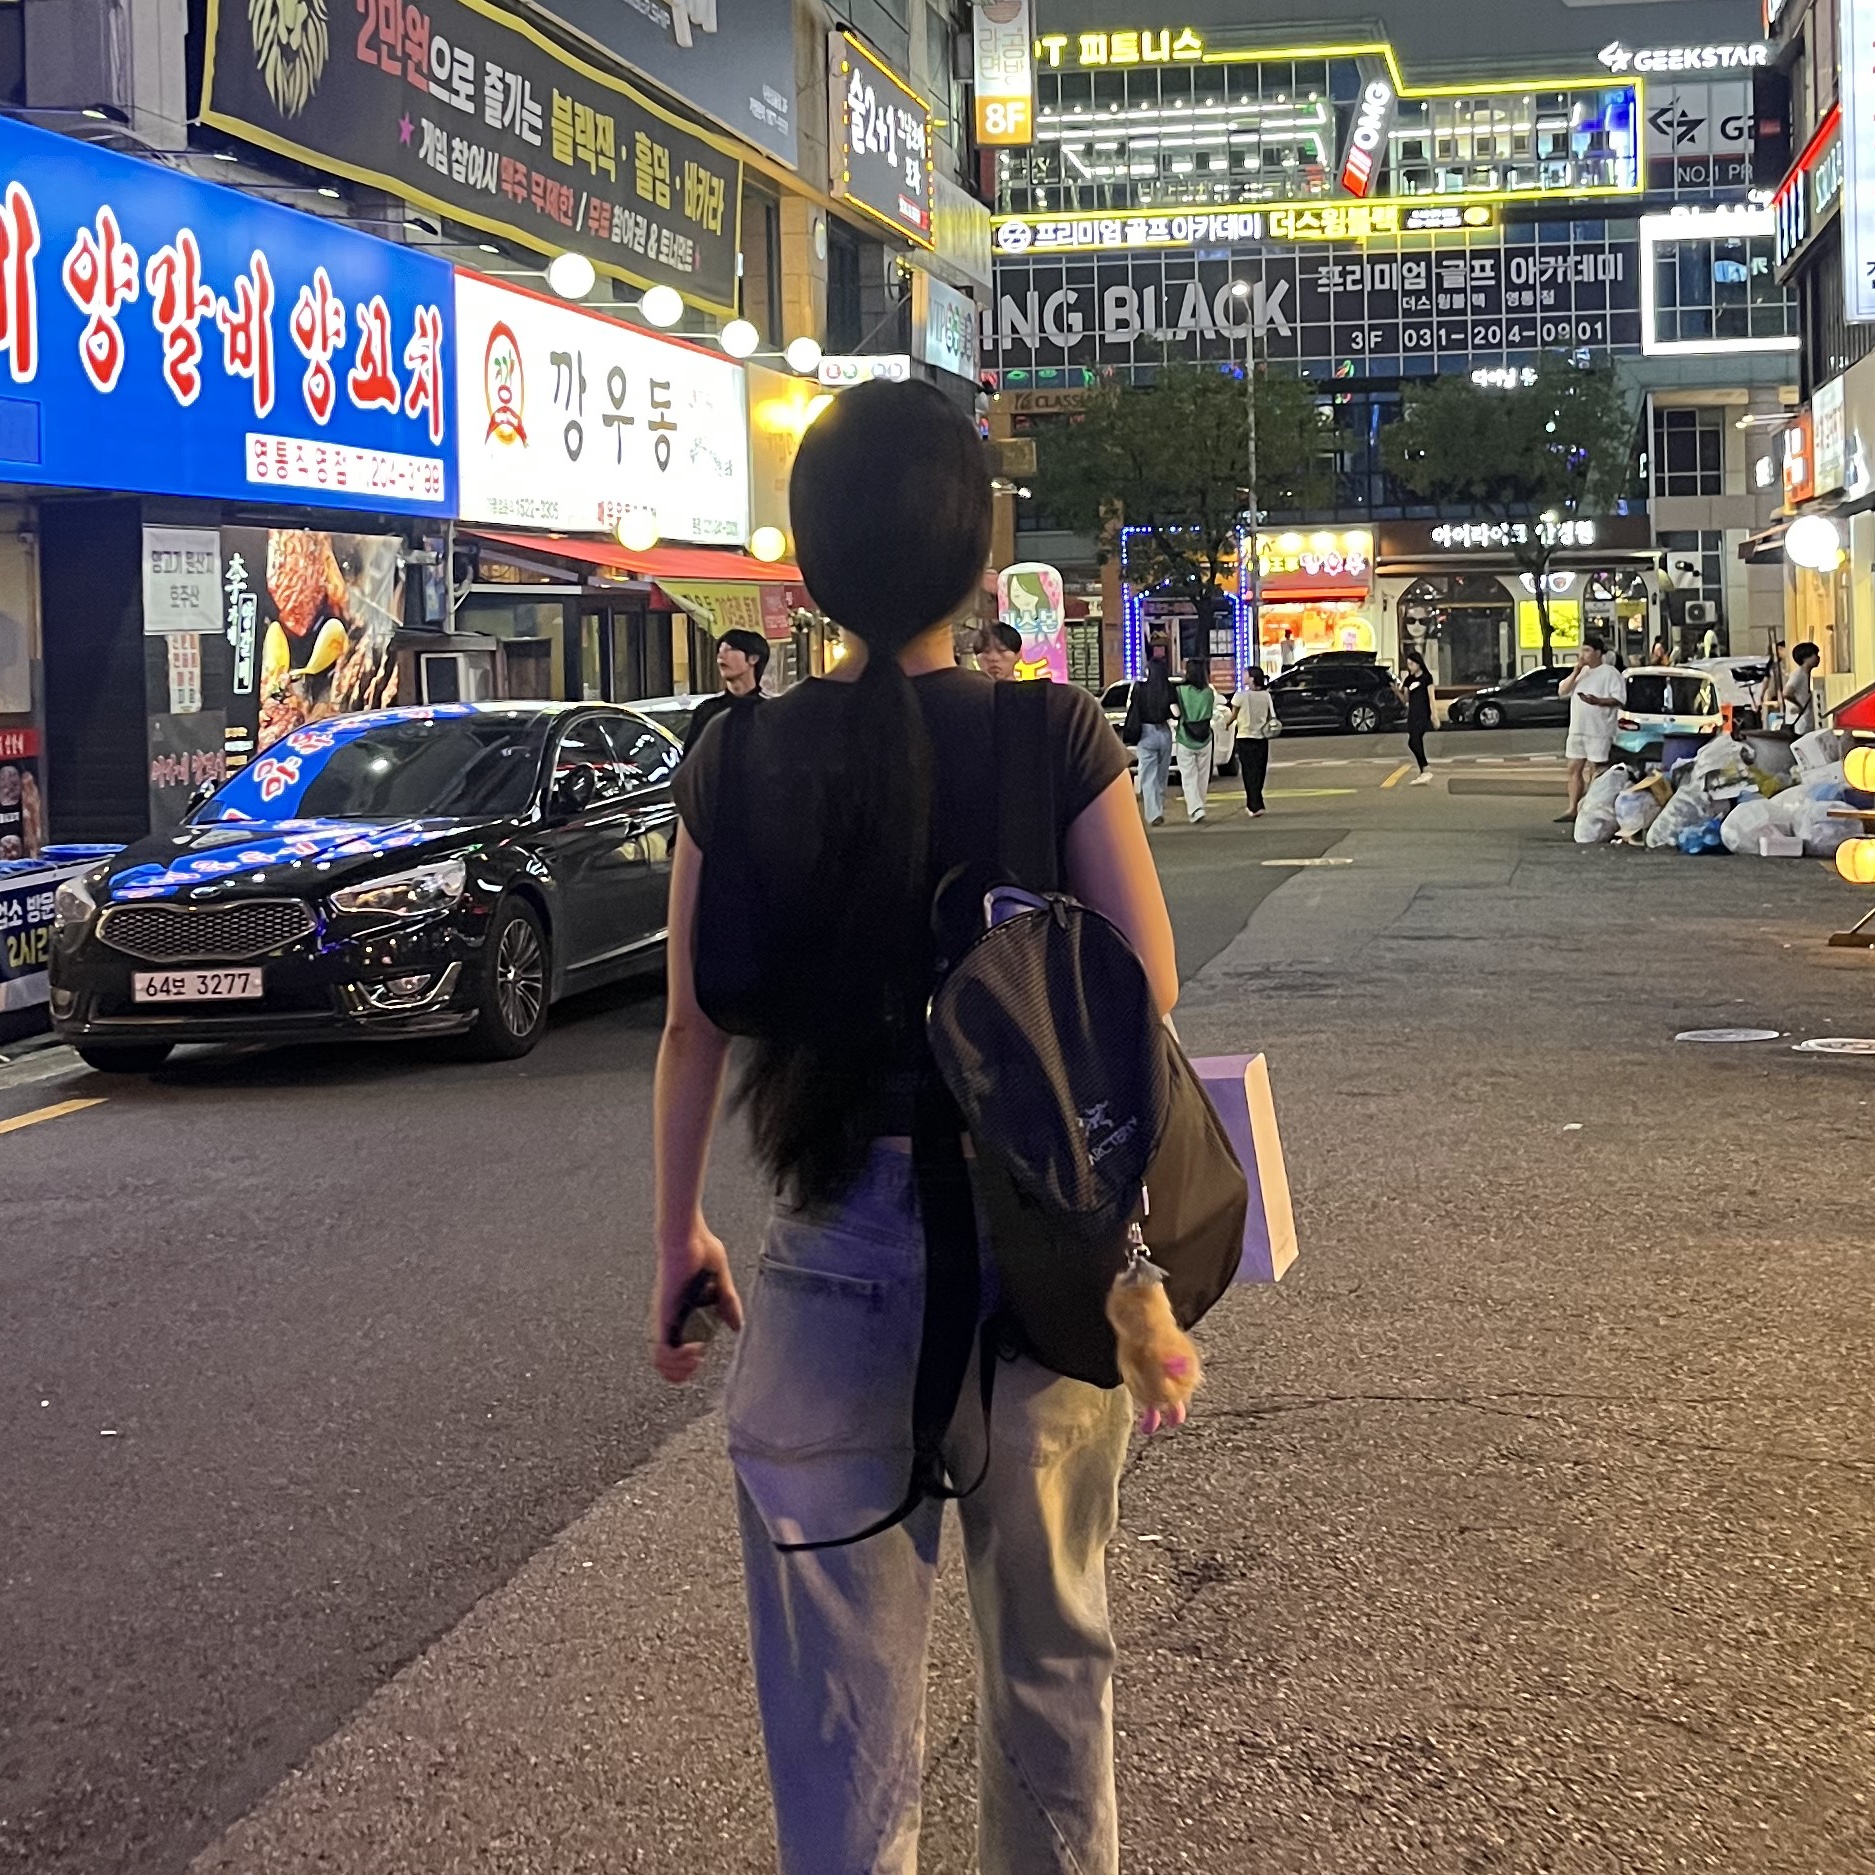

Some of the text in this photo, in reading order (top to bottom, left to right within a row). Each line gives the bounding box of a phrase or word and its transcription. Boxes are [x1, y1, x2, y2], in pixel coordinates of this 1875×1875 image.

[1079, 28, 1202, 65] 피트니스
[1633, 44, 1769, 72] GEEKSTAR
[985, 102, 1027, 135] 8F
[484, 61, 543, 146] 즐기는
[551, 87, 616, 183] 블랙잭
[634, 130, 671, 210] 홀덤
[684, 159, 725, 236] 바카라
[418, 117, 449, 176] 게임
[451, 137, 499, 195] 참여시
[531, 171, 575, 227] 무제한
[1035, 219, 1122, 247] 프리미엄
[1316, 252, 1625, 293] 프리미엄 골프 아카데미
[62, 204, 276, 420] 양갈비
[289, 265, 445, 447] 양꼬치
[1103, 278, 1293, 344] BLACK
[1350, 320, 1604, 350] 3F 031-204-0901
[549, 349, 678, 473] 깡우동
[145, 972, 251, 997] 64보 3277
